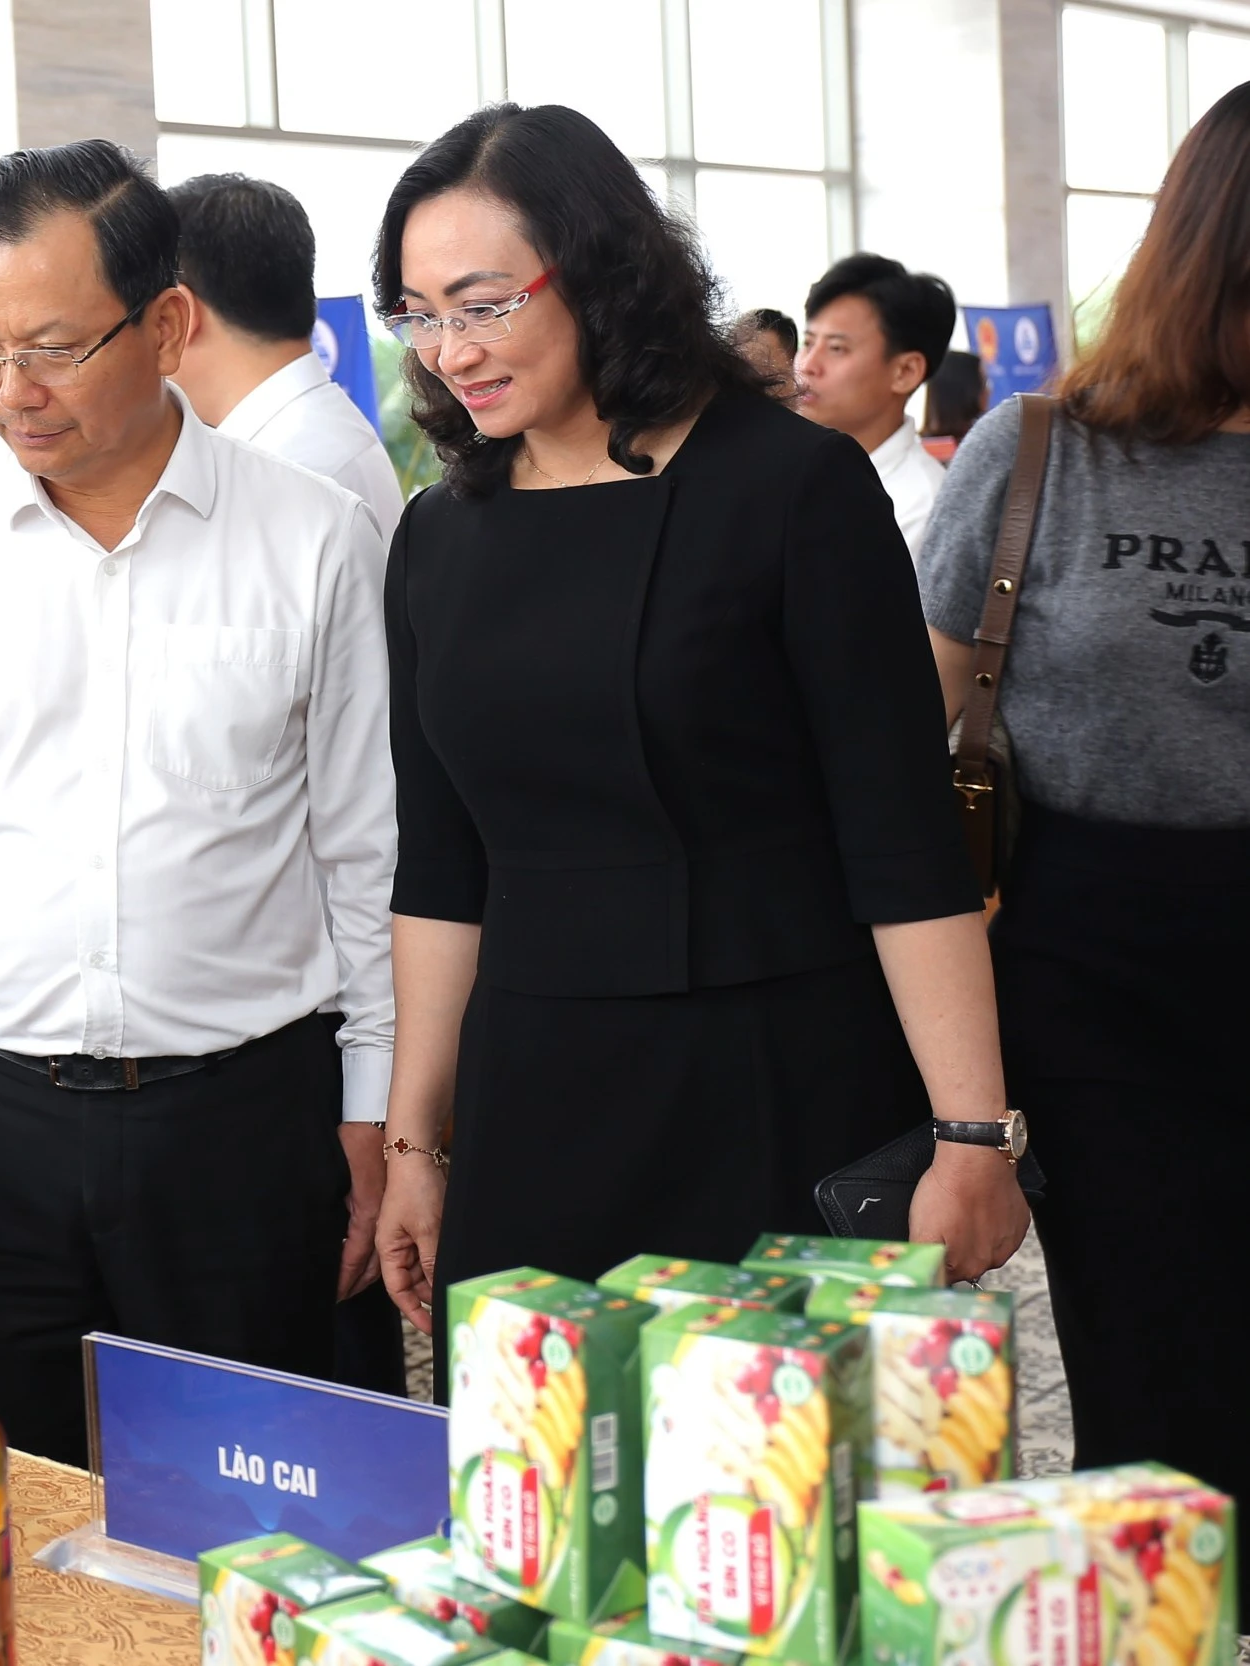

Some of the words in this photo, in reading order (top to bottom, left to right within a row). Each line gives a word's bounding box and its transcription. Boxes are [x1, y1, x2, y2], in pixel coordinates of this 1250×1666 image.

[1166, 582, 1250, 606] MILAN
[217, 1444, 266, 1486] LÀO
[272, 1460, 317, 1498] CAI
